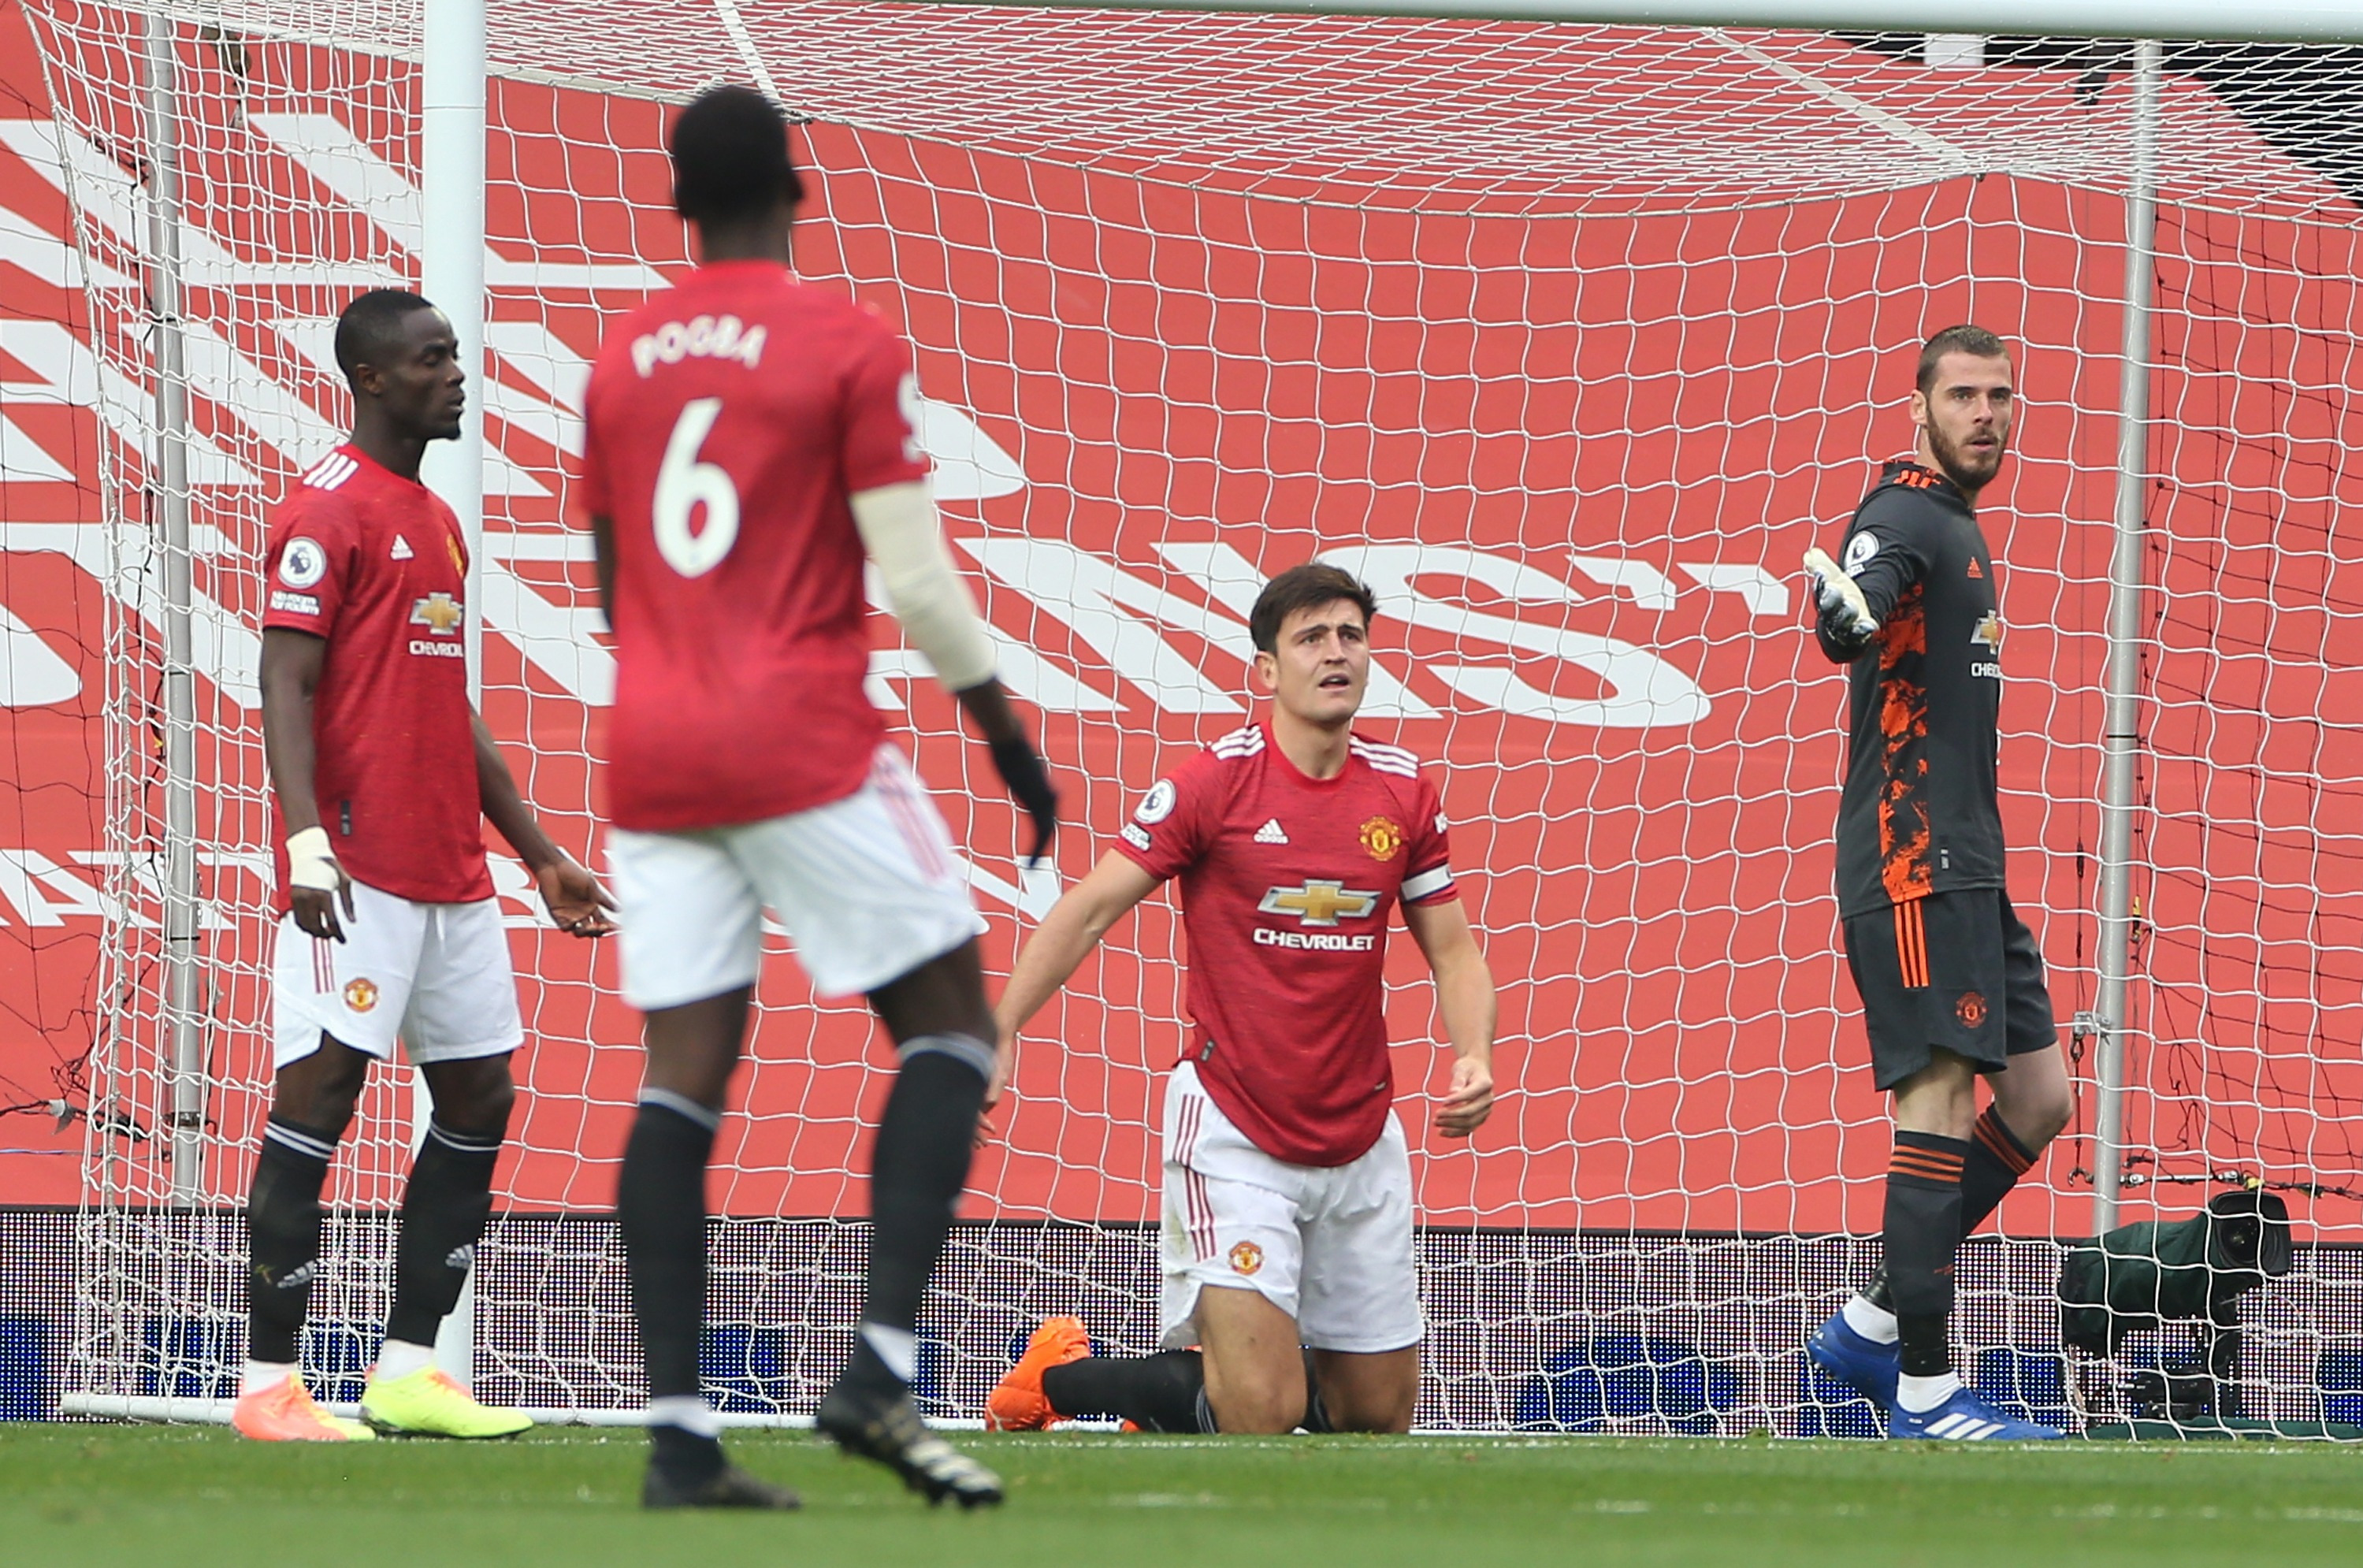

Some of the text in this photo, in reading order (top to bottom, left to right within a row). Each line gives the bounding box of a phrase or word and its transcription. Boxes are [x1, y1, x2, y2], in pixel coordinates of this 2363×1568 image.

[631, 314, 767, 378] POGBA
[652, 396, 741, 578] 6
[1253, 927, 1375, 950] CHEVROLET
